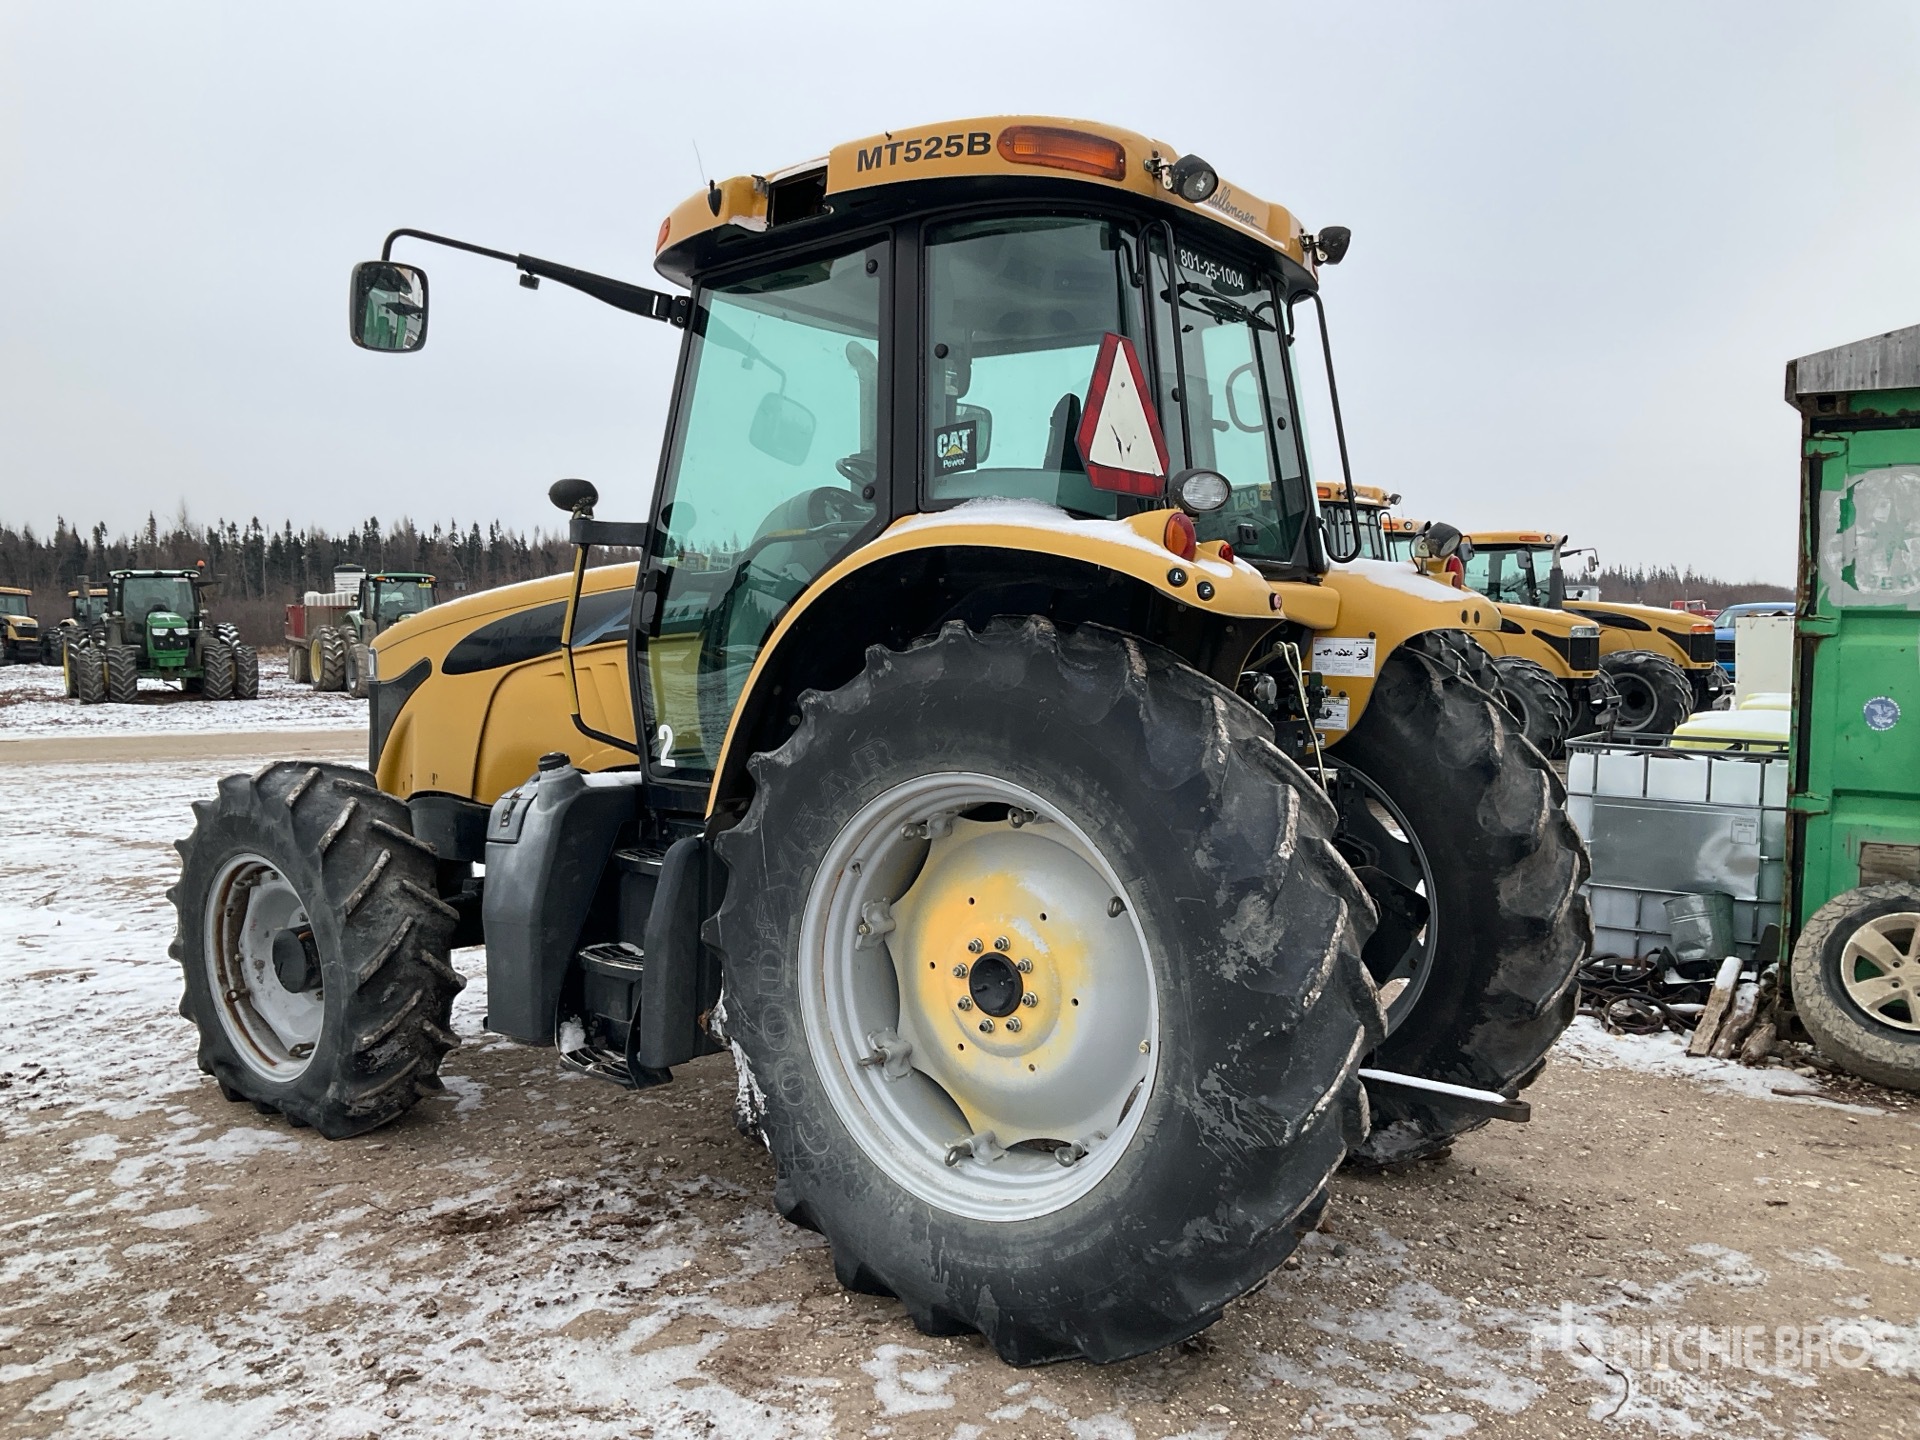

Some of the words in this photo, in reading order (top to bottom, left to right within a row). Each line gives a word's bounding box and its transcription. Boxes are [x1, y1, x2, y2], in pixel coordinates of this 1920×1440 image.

[857, 132, 991, 172] MT525B
[1180, 249, 1244, 290] 801-25-1004
[937, 429, 971, 458] CAT
[943, 458, 966, 468] Power
[658, 724, 676, 768] 2
